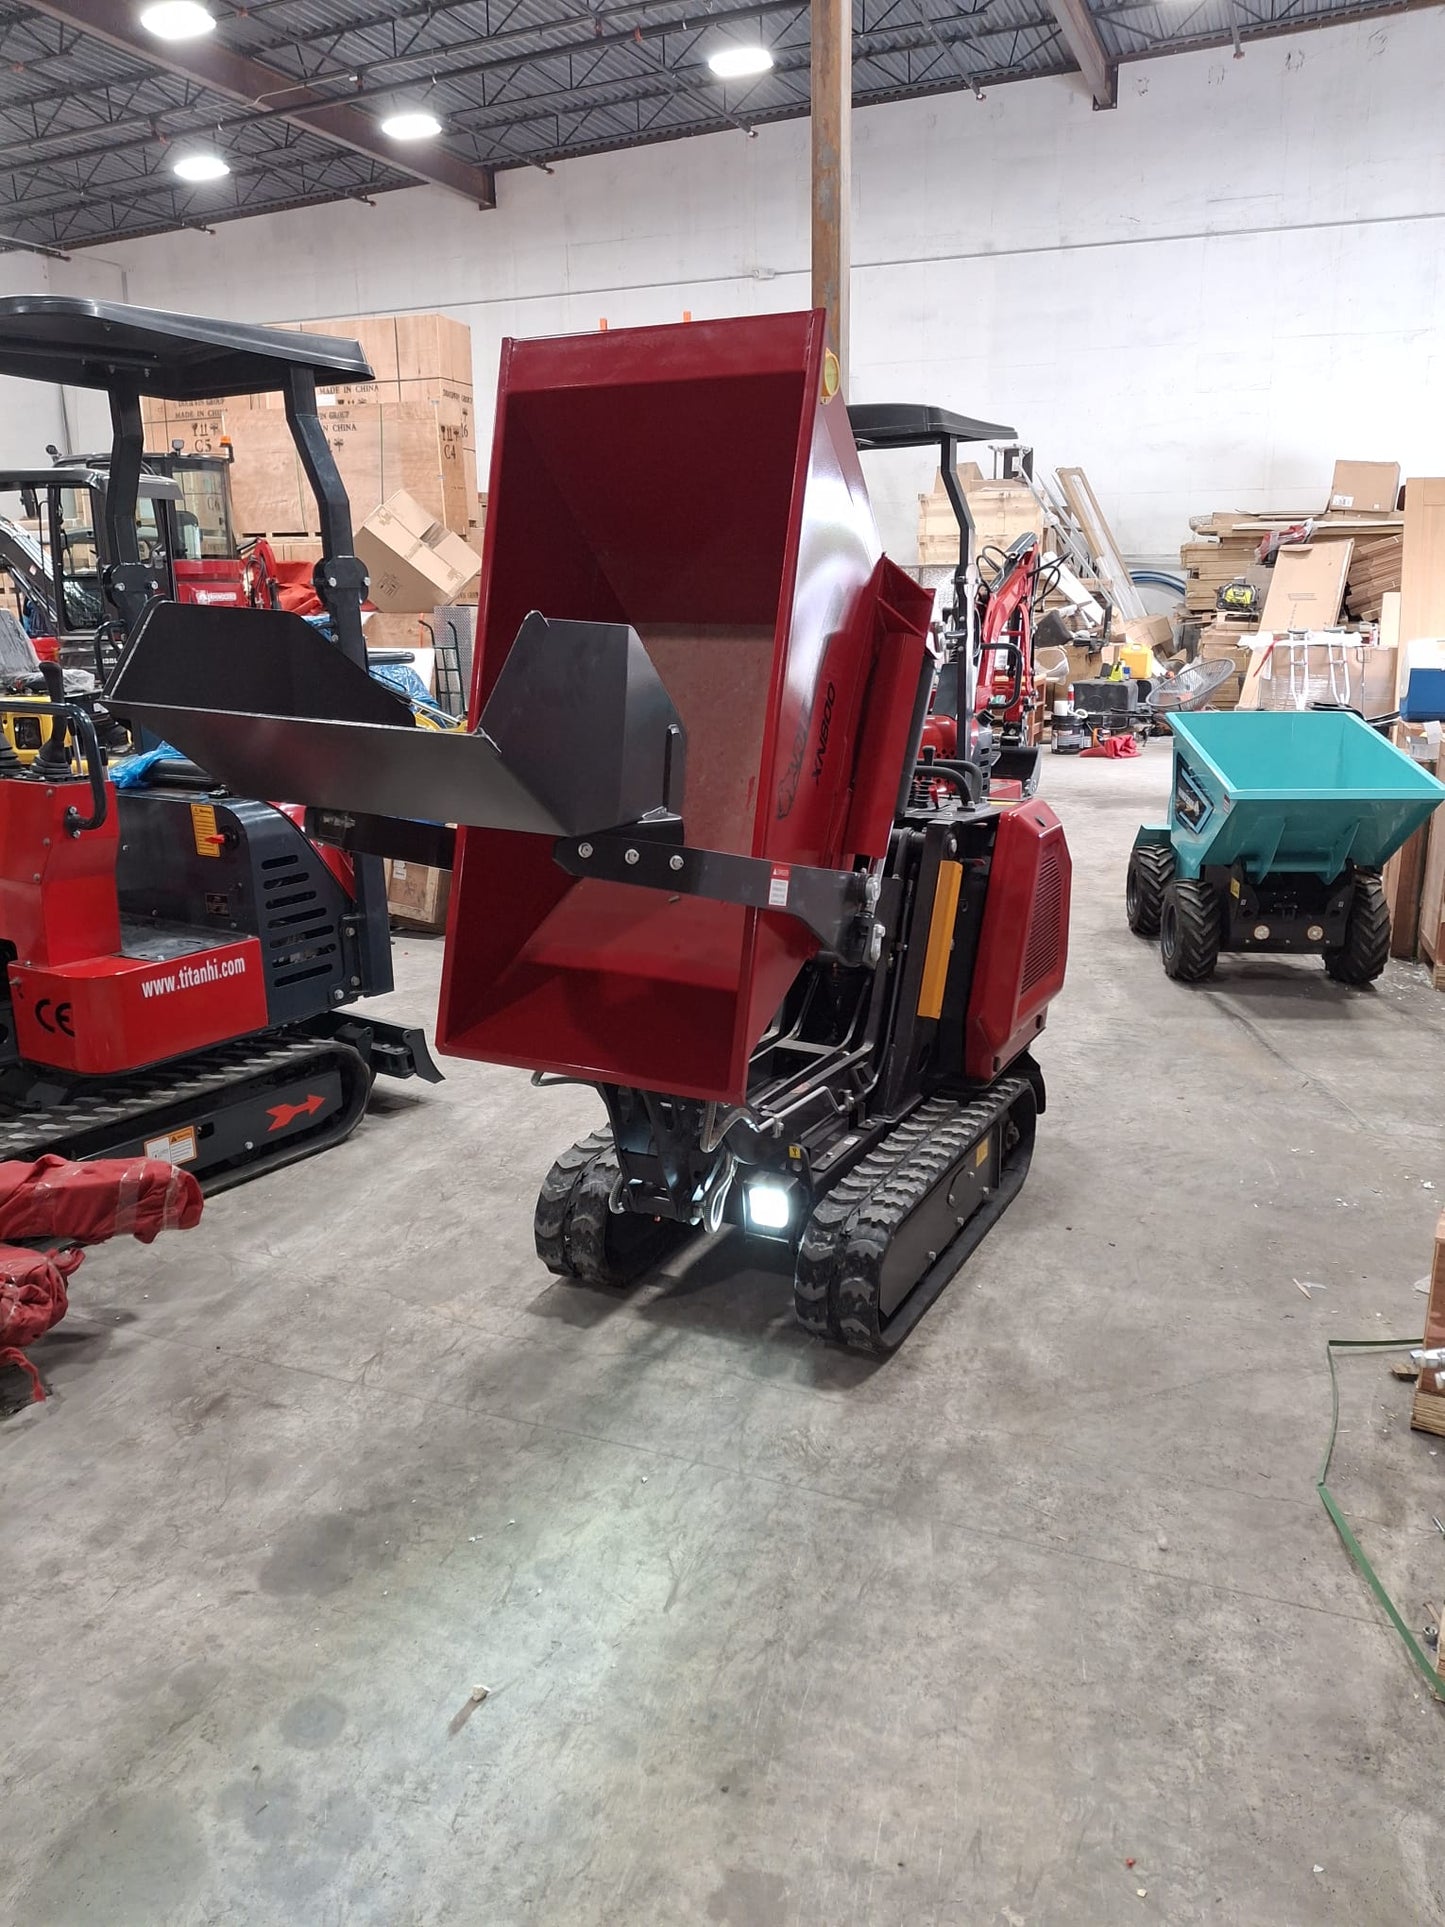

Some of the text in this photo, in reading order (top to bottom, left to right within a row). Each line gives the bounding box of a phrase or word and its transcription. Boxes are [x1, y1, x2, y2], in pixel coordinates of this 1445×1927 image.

[175, 410, 194, 418] MADE
[332, 424, 357, 432] CHINA
[194, 439, 212, 452] C5
[444, 444, 456, 460] C4
[141, 957, 246, 998] www.titanhi.com
[34, 998, 76, 1038] CE
